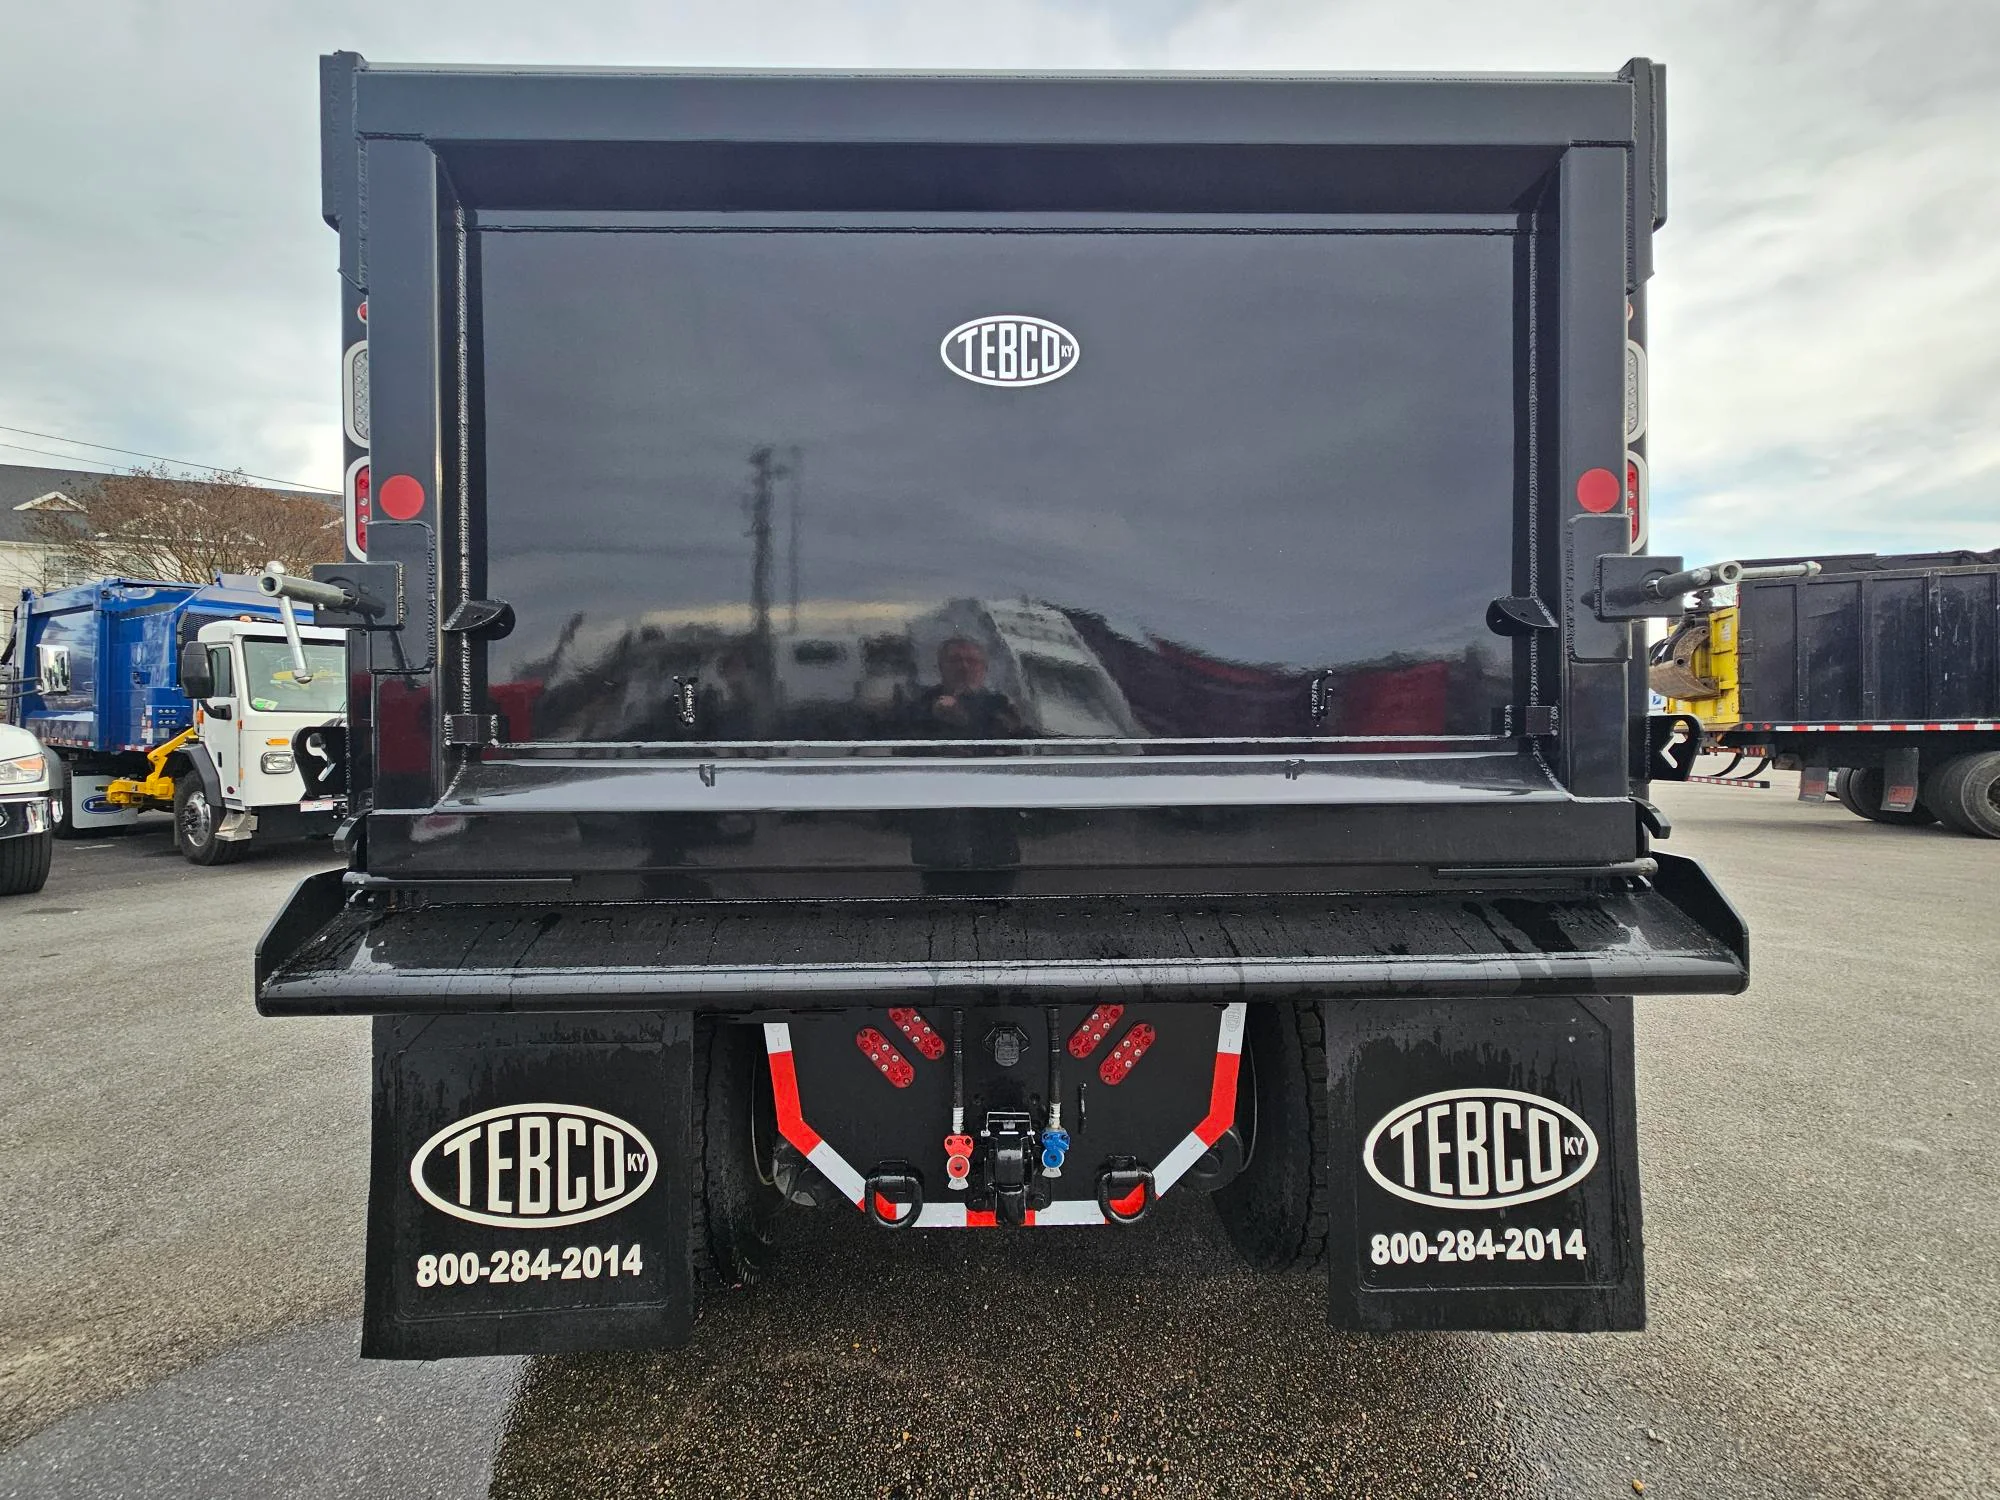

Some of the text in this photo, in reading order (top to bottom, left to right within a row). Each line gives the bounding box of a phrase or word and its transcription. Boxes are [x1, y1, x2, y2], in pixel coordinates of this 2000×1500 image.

[957, 322, 1073, 380] TEBCO KY
[443, 1116, 646, 1215] TEBCO KY
[1390, 1101, 1585, 1196] TEBCO KY
[416, 1244, 643, 1288] 800-284-2014
[1371, 1228, 1587, 1266] 800-284-2014
